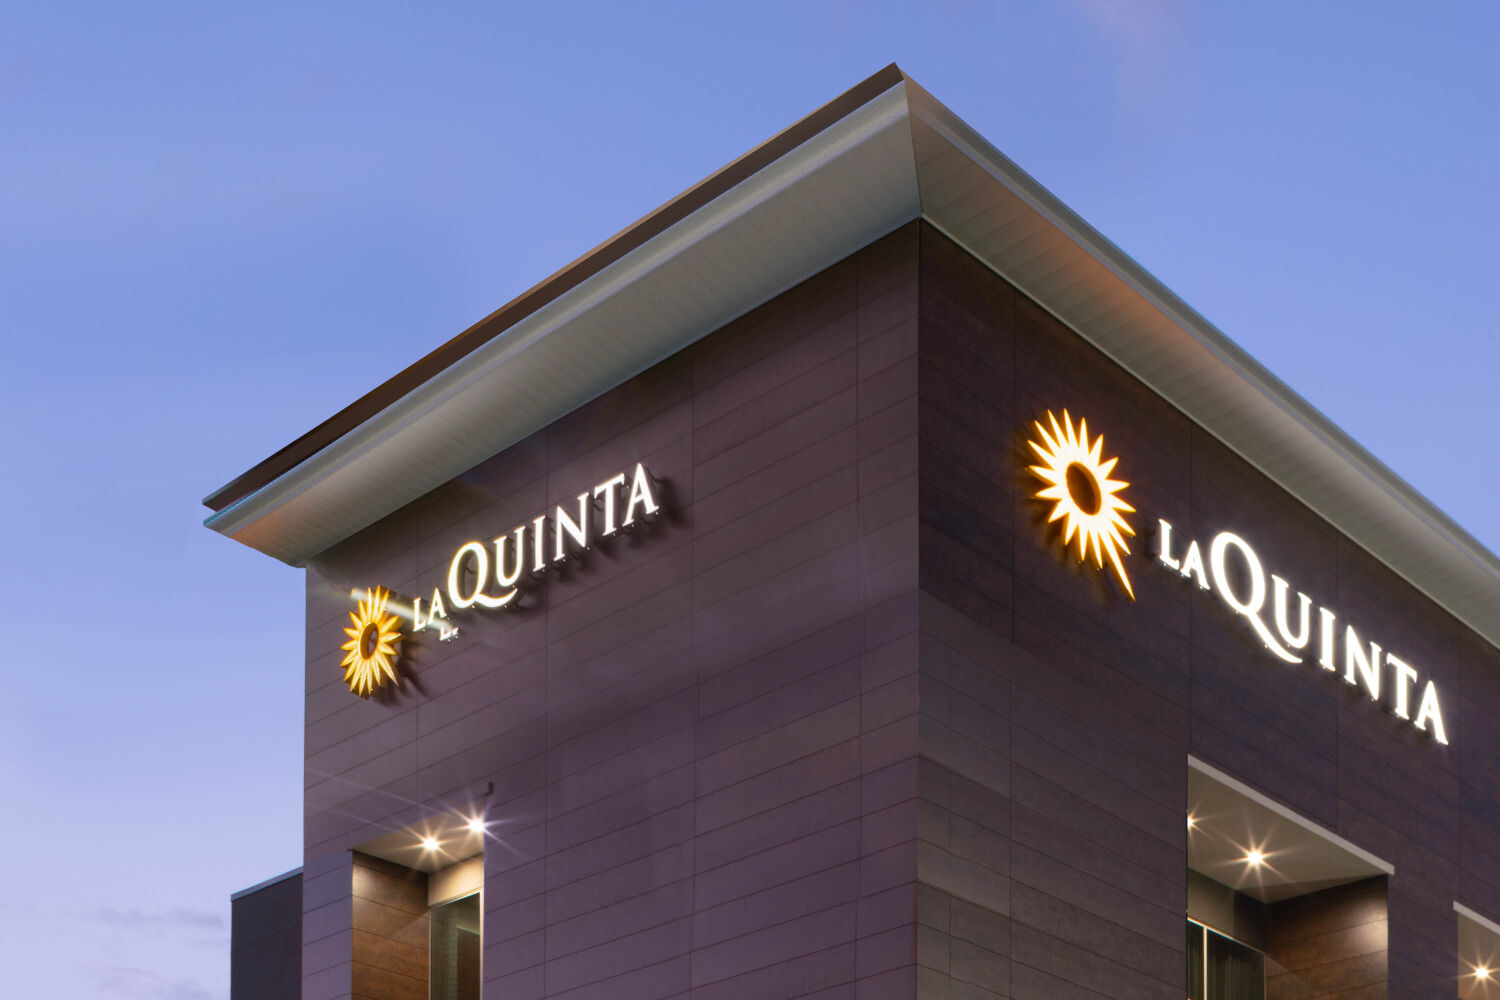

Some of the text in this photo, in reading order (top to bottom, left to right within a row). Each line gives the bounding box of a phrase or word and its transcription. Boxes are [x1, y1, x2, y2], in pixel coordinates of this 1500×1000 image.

[413, 462, 659, 632] LA QUINTA
[1158, 518, 1449, 745] LA QUINTA
